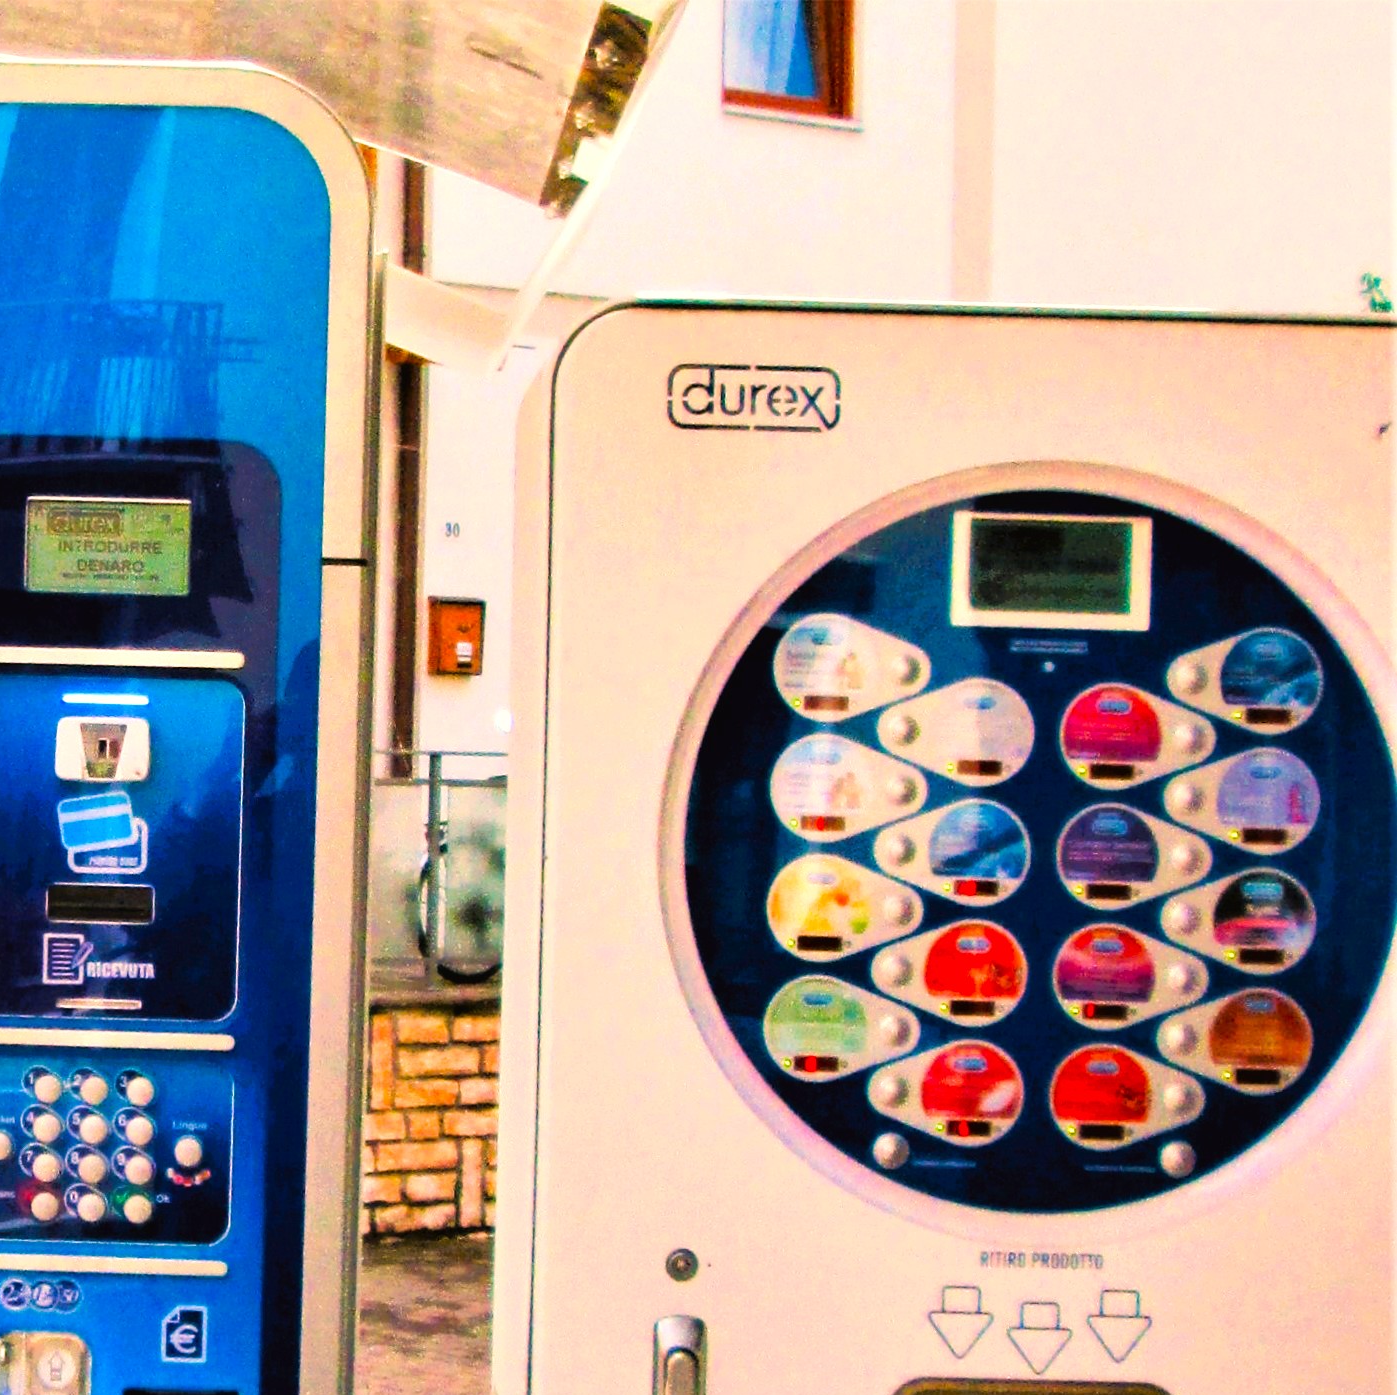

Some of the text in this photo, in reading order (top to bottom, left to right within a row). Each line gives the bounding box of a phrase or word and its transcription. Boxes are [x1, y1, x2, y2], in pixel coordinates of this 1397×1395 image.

[682, 367, 828, 428] durex
[444, 522, 460, 537] 30
[77, 558, 145, 572] DENARO
[86, 961, 155, 978] RICEVUTA
[980, 1251, 1104, 1270] RITIRO PRODOTTO
